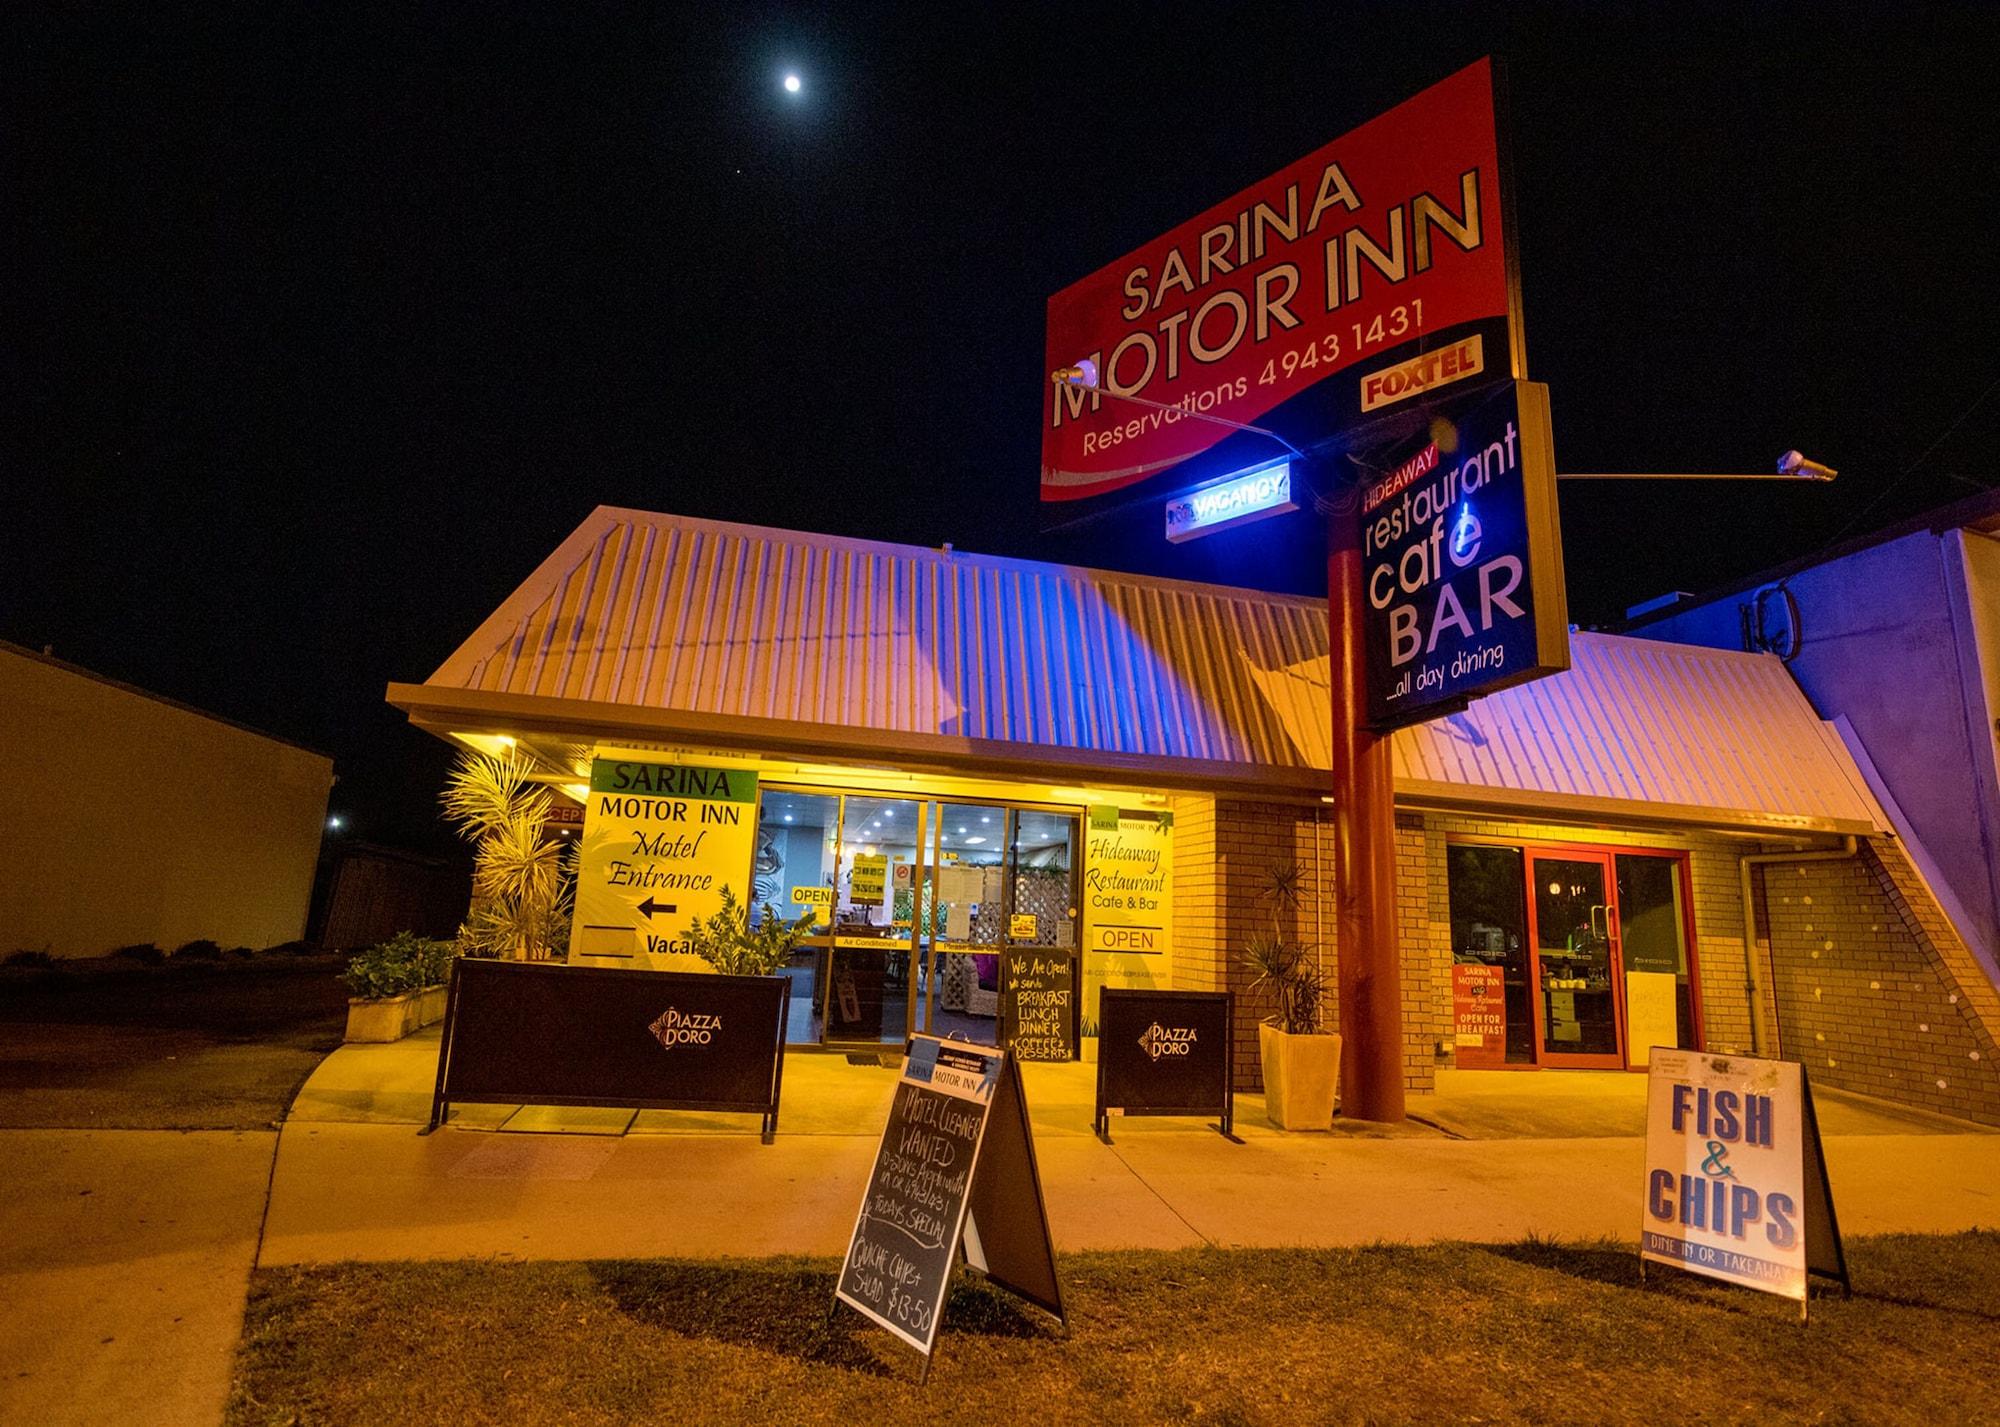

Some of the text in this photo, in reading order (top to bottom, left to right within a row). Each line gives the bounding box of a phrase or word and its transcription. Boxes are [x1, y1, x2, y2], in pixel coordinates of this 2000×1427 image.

[1122, 162, 1361, 321] SARINA
[1053, 168, 1482, 427] MOTOR INN
[1082, 298, 1423, 458] Reservations 4943 1431
[1366, 343, 1475, 406] FOXTEL
[1364, 446, 1435, 513] HIDEAWAY
[1365, 421, 1517, 557] restaurant
[1193, 471, 1286, 518] VACANCY
[1390, 554, 1526, 667] BAR
[1416, 661, 1446, 690] day
[1450, 643, 1504, 680] dining
[613, 762, 731, 797] SARINA
[600, 797, 740, 825] MOTOR INN
[1091, 820, 1118, 828] SARINA
[1120, 822, 1145, 831] MOTOR
[632, 830, 707, 858] Motel
[1090, 836, 1160, 874] Hideaway
[608, 861, 713, 891] Entrance
[1086, 868, 1165, 892] Restaurant
[793, 888, 830, 902] OPEN
[1092, 895, 1158, 910] Cafe & Bar
[855, 938, 897, 948] Conditioned
[1102, 930, 1154, 949] OPEN
[1011, 955, 1027, 975] We
[1464, 967, 1492, 977] SARINA
[1458, 976, 1500, 986] MOTOR INN
[1017, 990, 1070, 1007] BREAKFAST
[667, 1010, 721, 1030] PIAZZA
[1018, 1007, 1059, 1020] LUNCH
[1460, 1014, 1500, 1024] OPEN FOR
[1020, 1020, 1061, 1037] DINNER
[1153, 1025, 1197, 1041] PIAZZA
[1456, 1024, 1504, 1035] BREAKFAST
[1015, 1037, 1057, 1049] COFFEE
[1016, 1048, 1066, 1059] DESSERTS
[935, 1070, 960, 1087] MOTOR
[903, 1087, 982, 1140] MOTEL CLEANER
[1672, 1084, 1773, 1148] FISH
[899, 1125, 956, 1167] WANTED
[1701, 1140, 1738, 1182] &
[1649, 1168, 1797, 1249] CHIPS
[1650, 1234, 1675, 1254] DINE
[1681, 1242, 1694, 1258] IN
[1699, 1246, 1715, 1263] OR
[852, 1268, 884, 1303] SALAD
